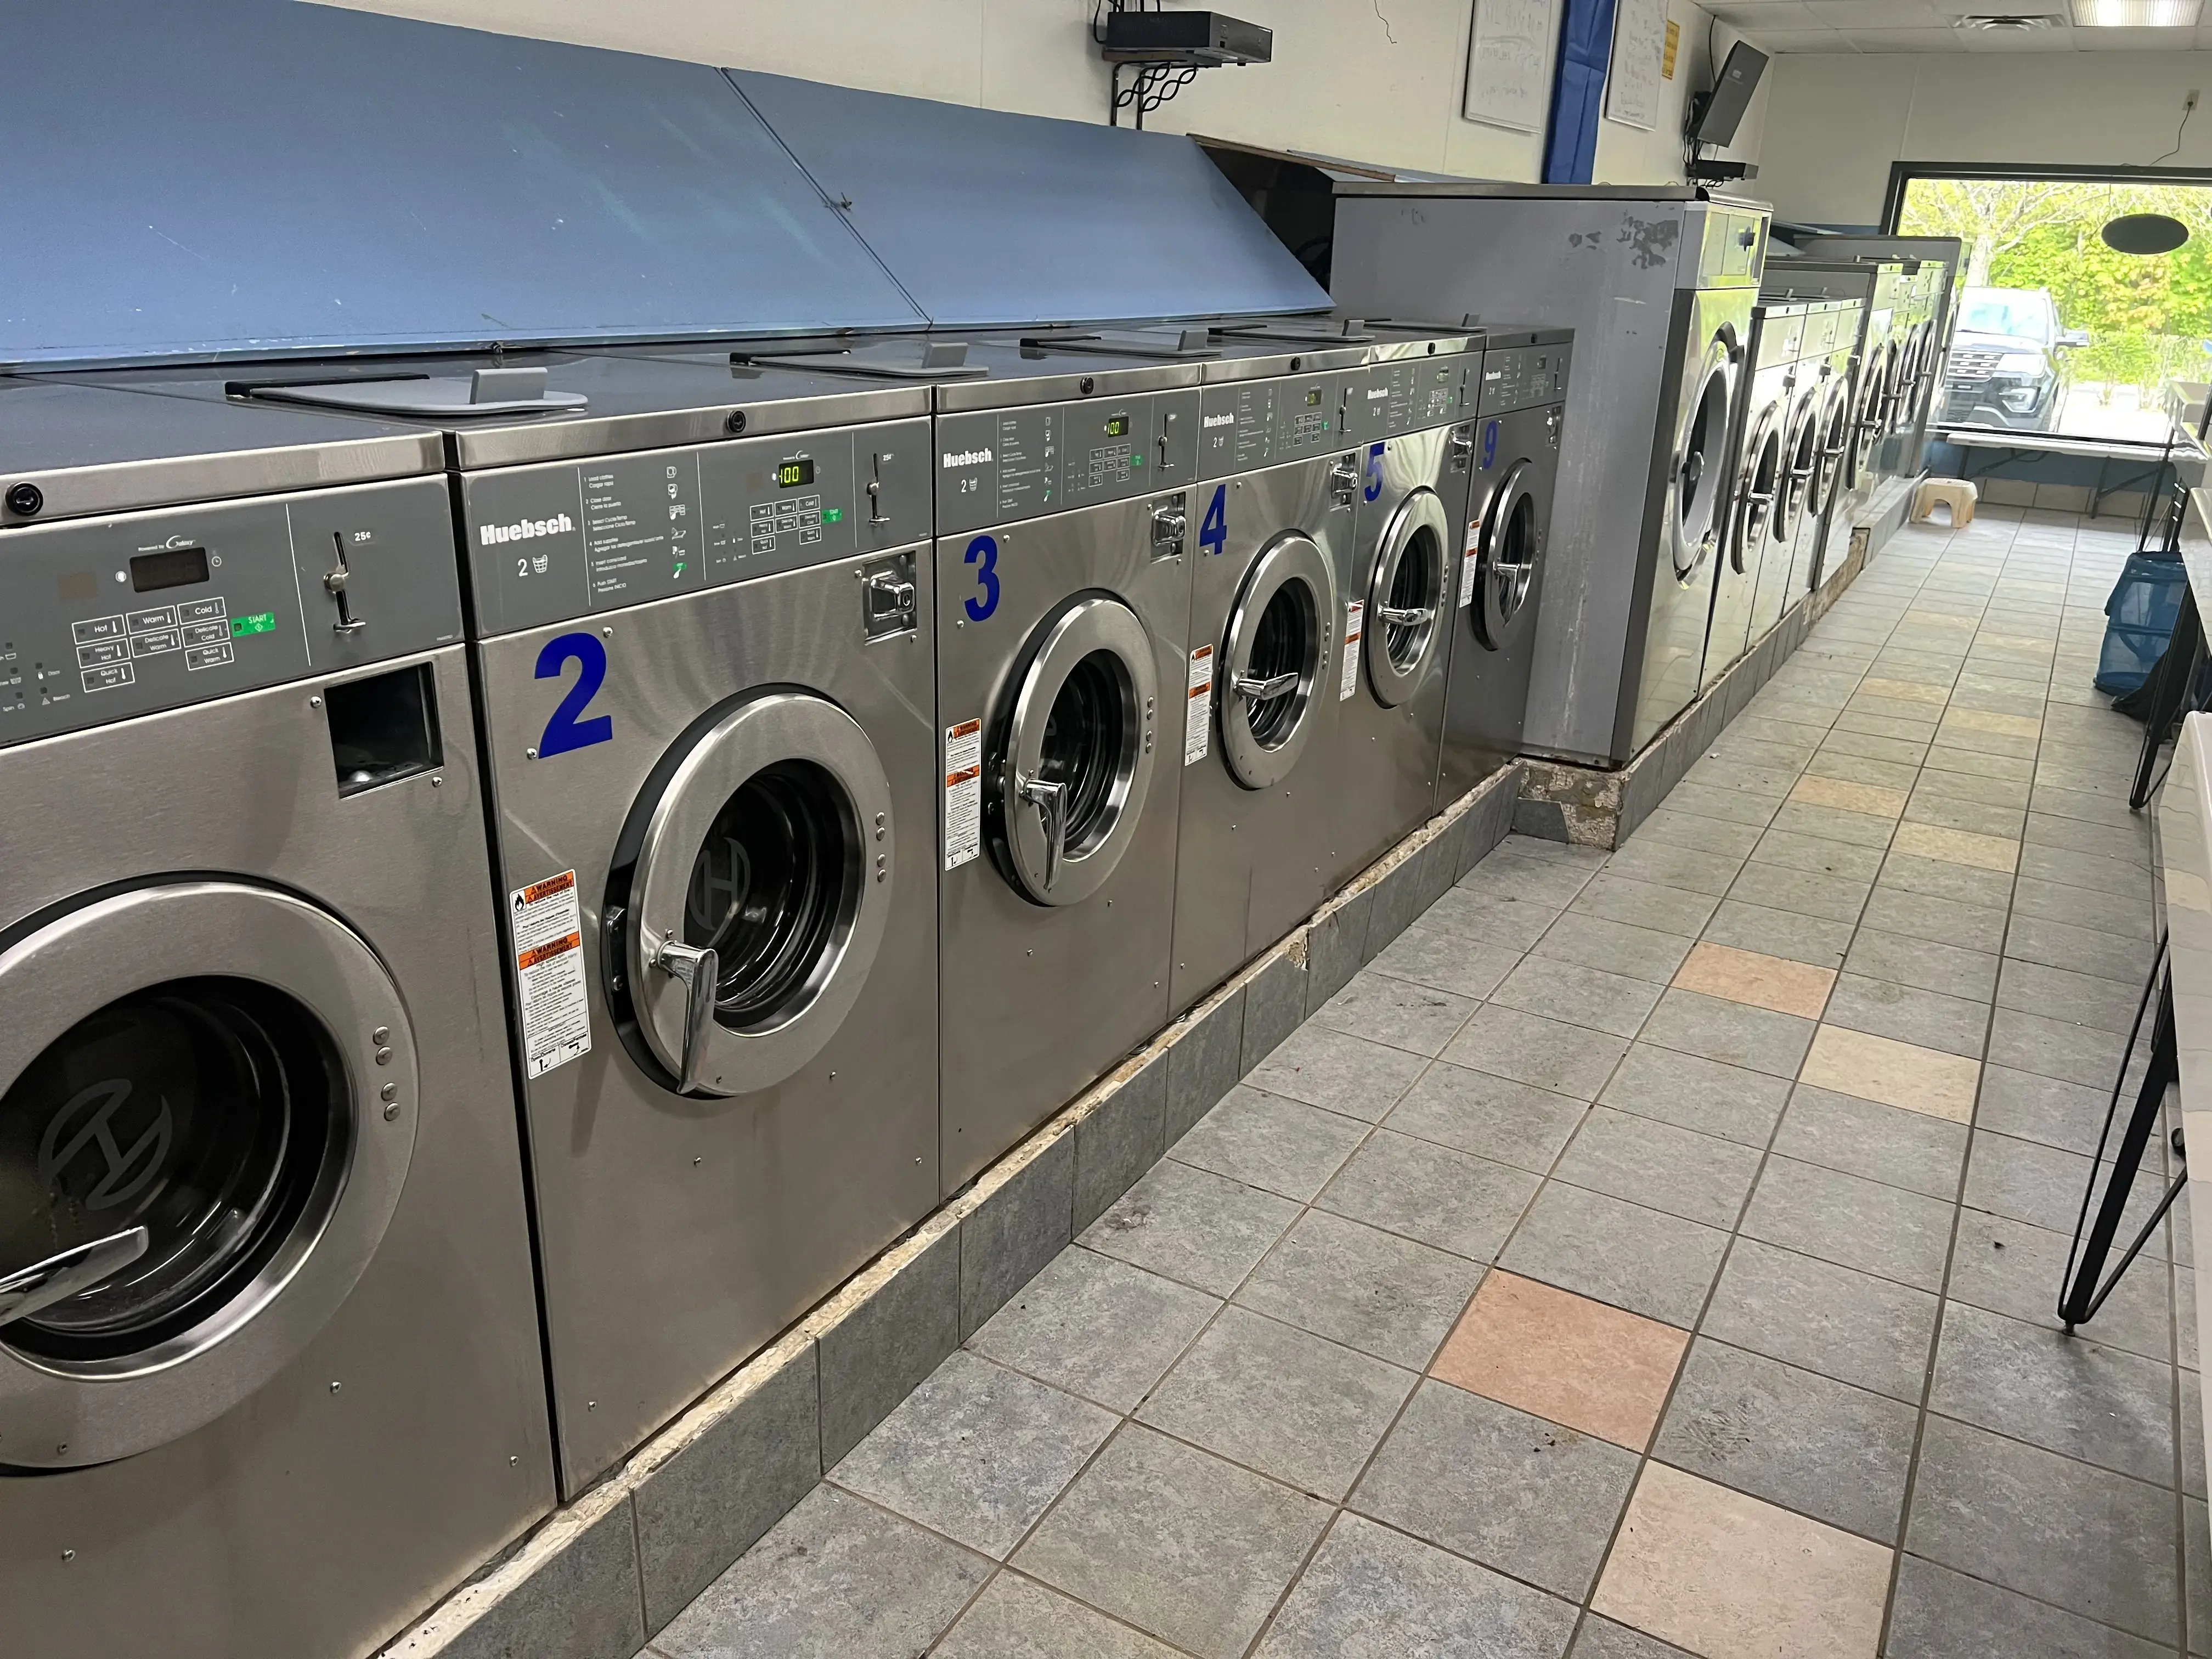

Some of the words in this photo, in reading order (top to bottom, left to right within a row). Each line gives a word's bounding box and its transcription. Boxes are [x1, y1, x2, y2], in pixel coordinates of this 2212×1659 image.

[1204, 413, 1234, 428] Huebsch
[1213, 437, 1217, 448] 2
[1483, 420, 1498, 470] 9
[943, 448, 992, 469] Huebsch
[1364, 442, 1385, 501] 5
[961, 479, 967, 493] 2
[1200, 484, 1227, 555] 4
[355, 531, 371, 541] 25¢
[480, 514, 572, 545] Huebsch
[517, 558, 528, 577] 2
[964, 535, 1000, 622] 3
[195, 606, 212, 615] Cold
[248, 614, 267, 623] START
[143, 615, 165, 624] Warm
[195, 625, 218, 634] Delicate
[145, 634, 169, 643] Delicate
[534, 633, 613, 759] 2
[535, 874, 568, 891] WARNING
[535, 936, 568, 953] WARNING
